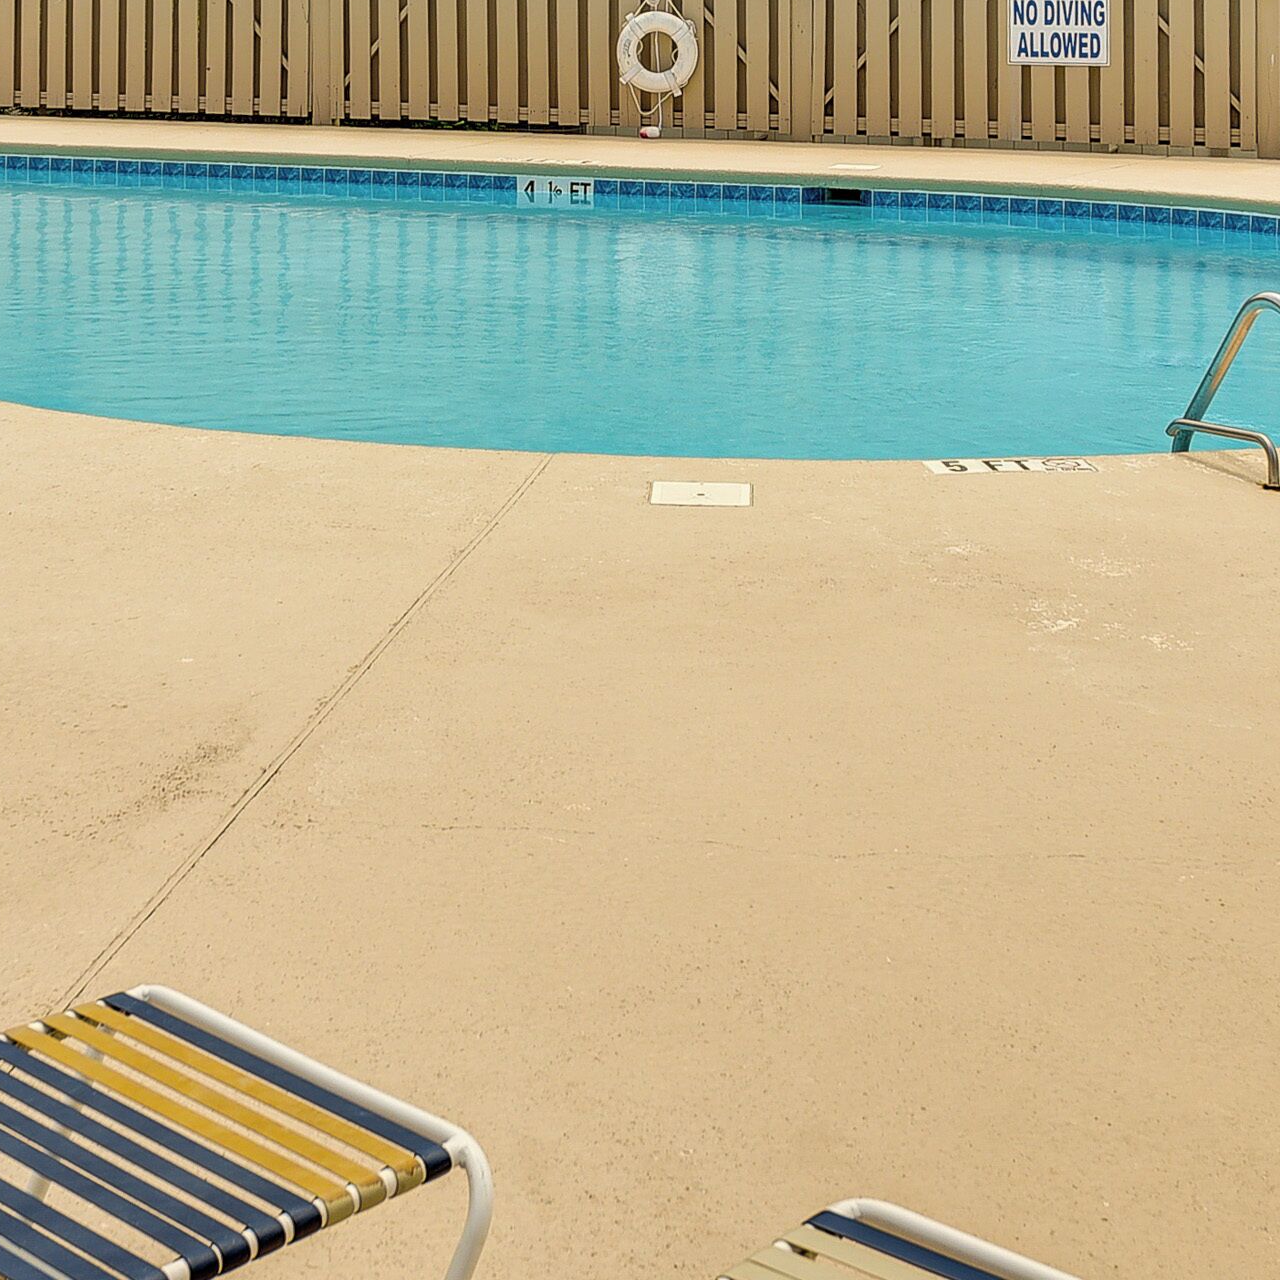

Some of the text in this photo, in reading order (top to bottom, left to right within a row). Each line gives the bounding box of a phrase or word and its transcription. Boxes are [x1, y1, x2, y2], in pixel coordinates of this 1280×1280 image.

[1013, 0, 1105, 26] NO DIVING
[1017, 32, 1101, 58] ALLOWED
[570, 181, 592, 197] FT
[941, 460, 1030, 472] 5 FT
